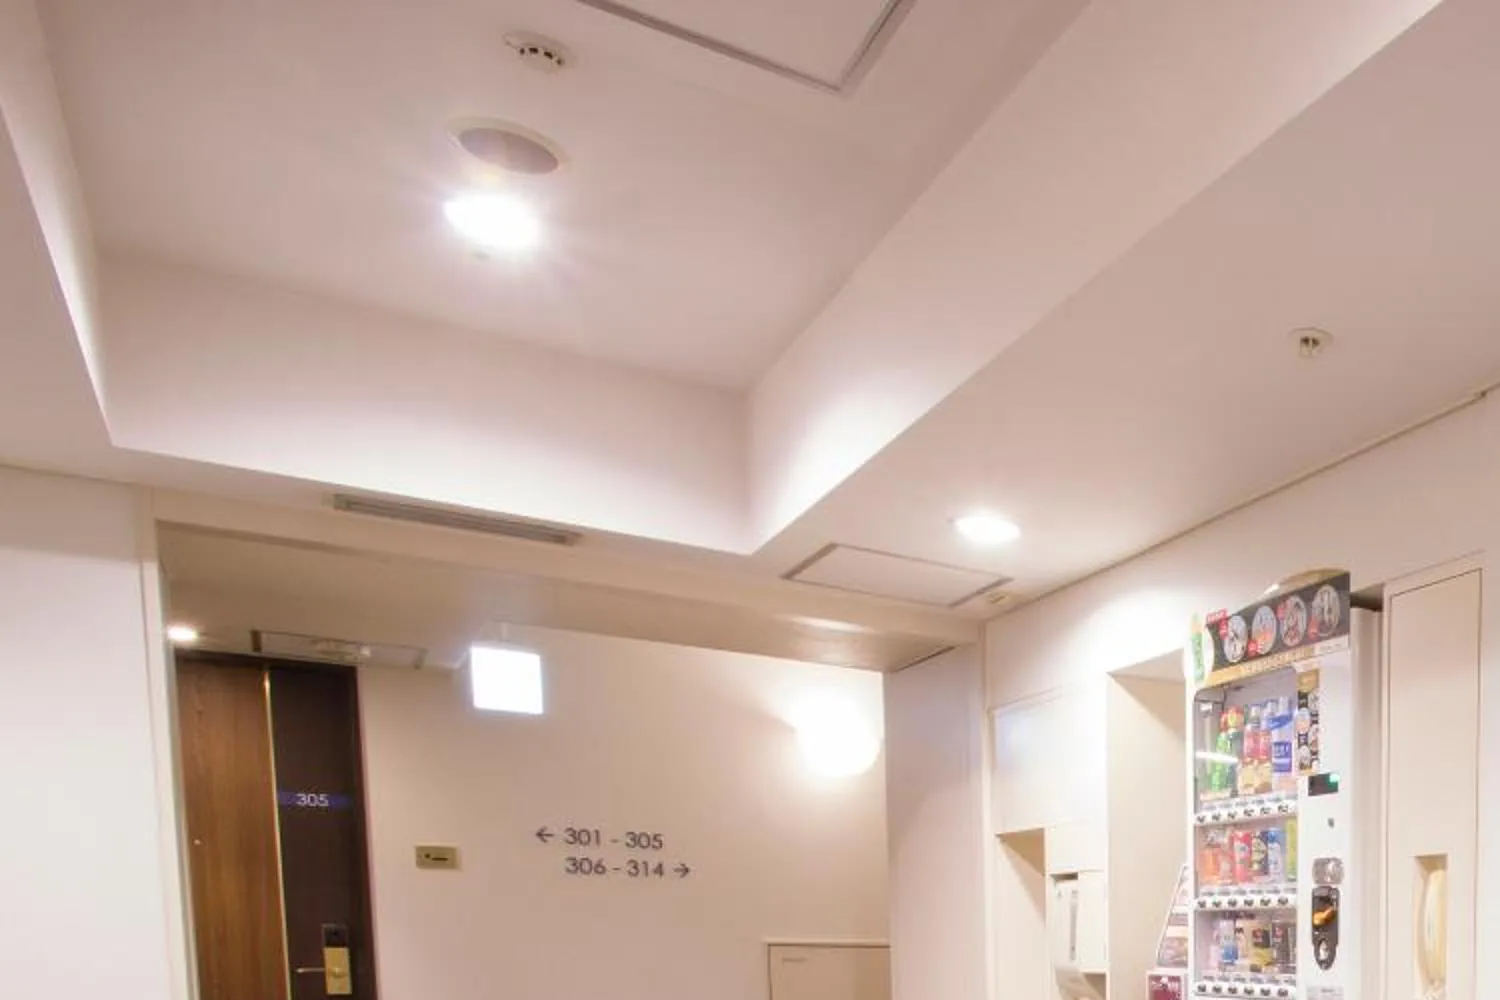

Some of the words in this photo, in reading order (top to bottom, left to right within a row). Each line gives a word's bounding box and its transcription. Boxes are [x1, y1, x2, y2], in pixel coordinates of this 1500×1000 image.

[296, 793, 329, 807] 305
[564, 827, 601, 846] 301
[625, 831, 664, 850] 305
[565, 857, 607, 875] 306
[626, 859, 665, 877] 314
